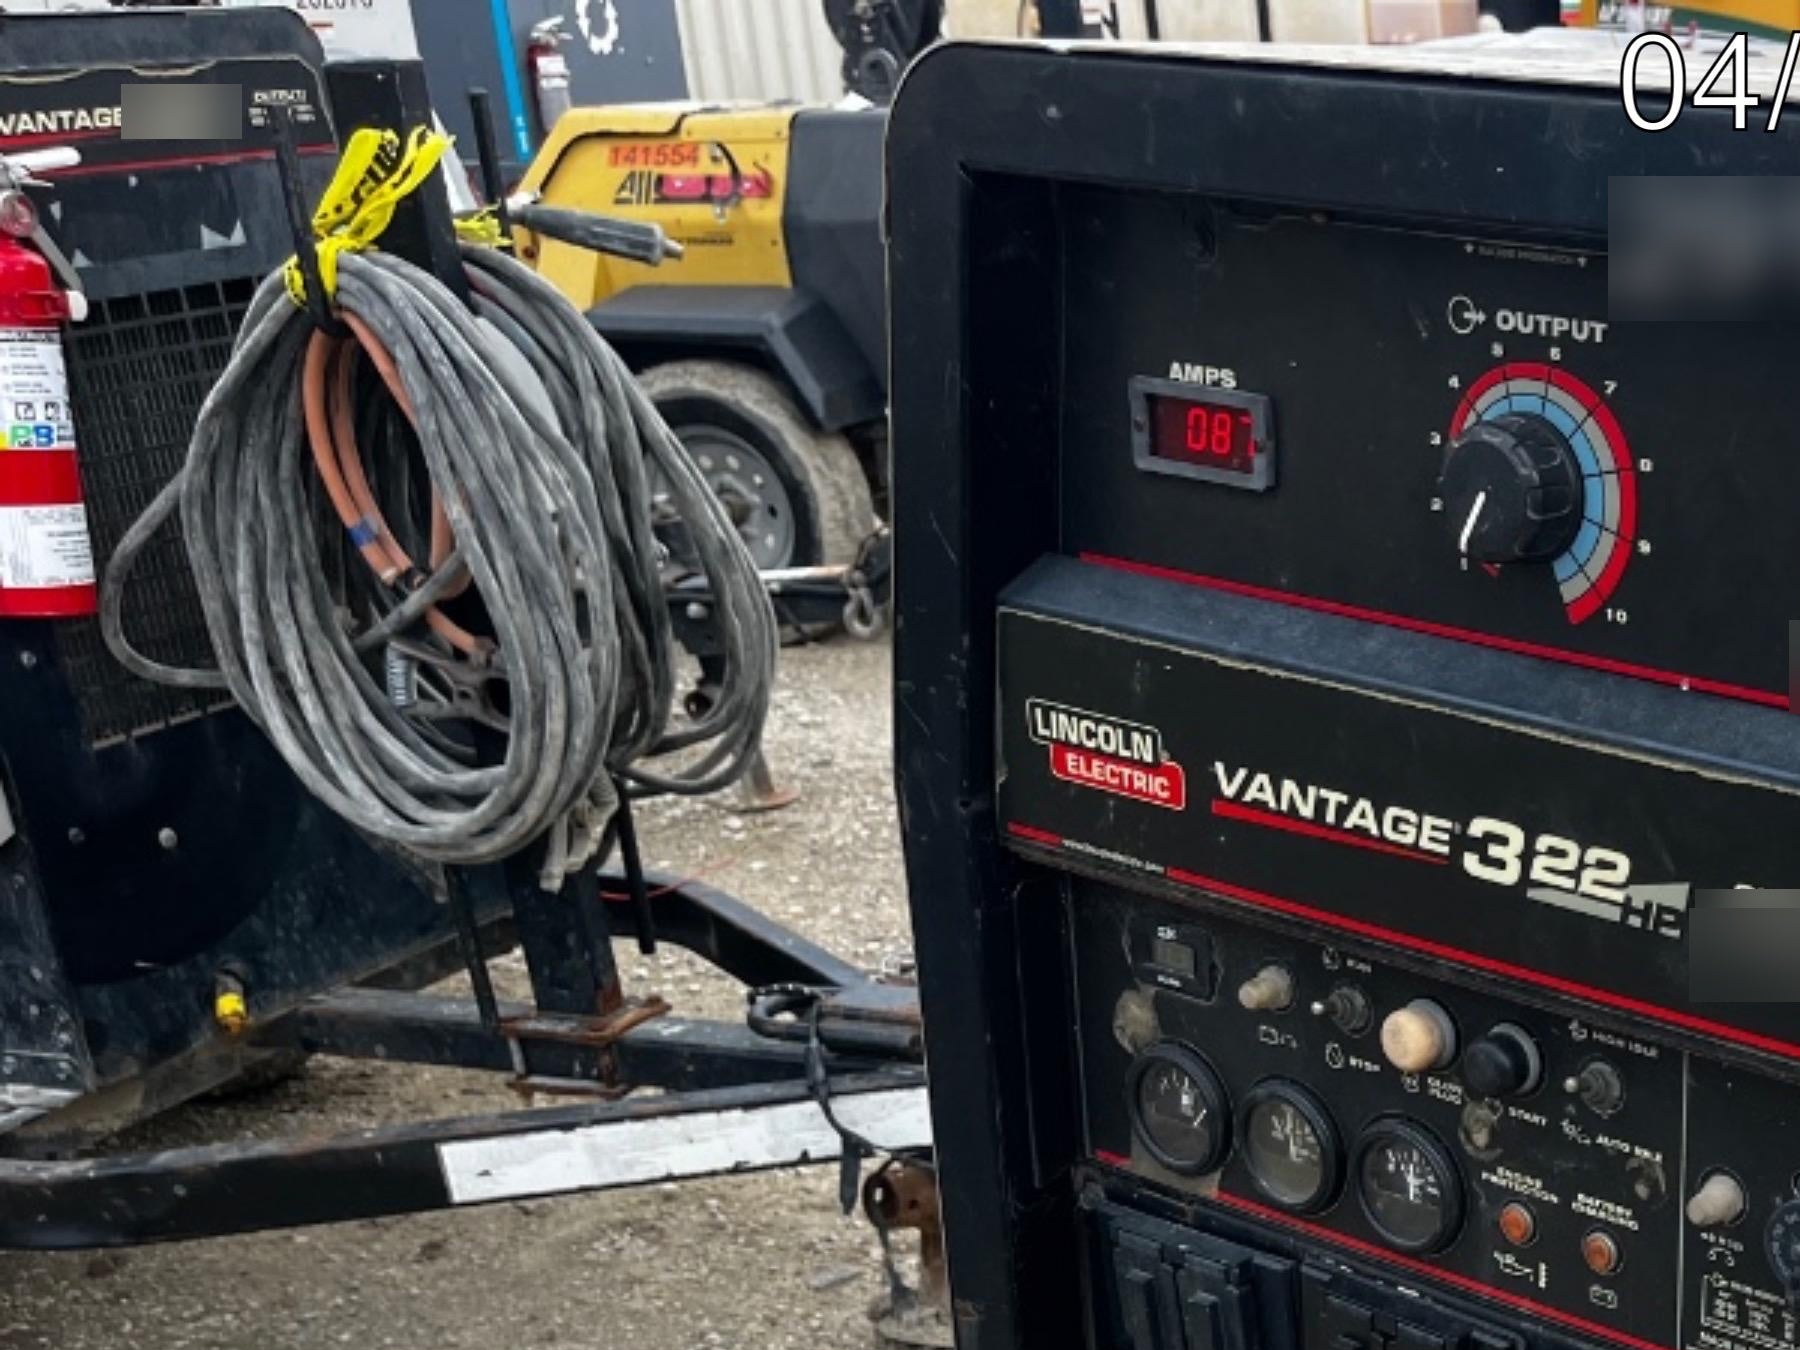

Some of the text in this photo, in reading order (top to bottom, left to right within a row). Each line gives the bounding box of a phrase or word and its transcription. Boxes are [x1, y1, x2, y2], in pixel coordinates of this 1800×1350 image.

[1495, 308, 1608, 345] OUTPUT
[1168, 361, 1238, 390] AMPS
[1604, 379, 1617, 395] 7
[1604, 608, 1628, 625] 10
[1033, 706, 1153, 763] LINCOLN
[1066, 753, 1171, 800] ELECTRIC
[1212, 760, 1451, 857] VANTAGE
[1462, 816, 1630, 904] 322
